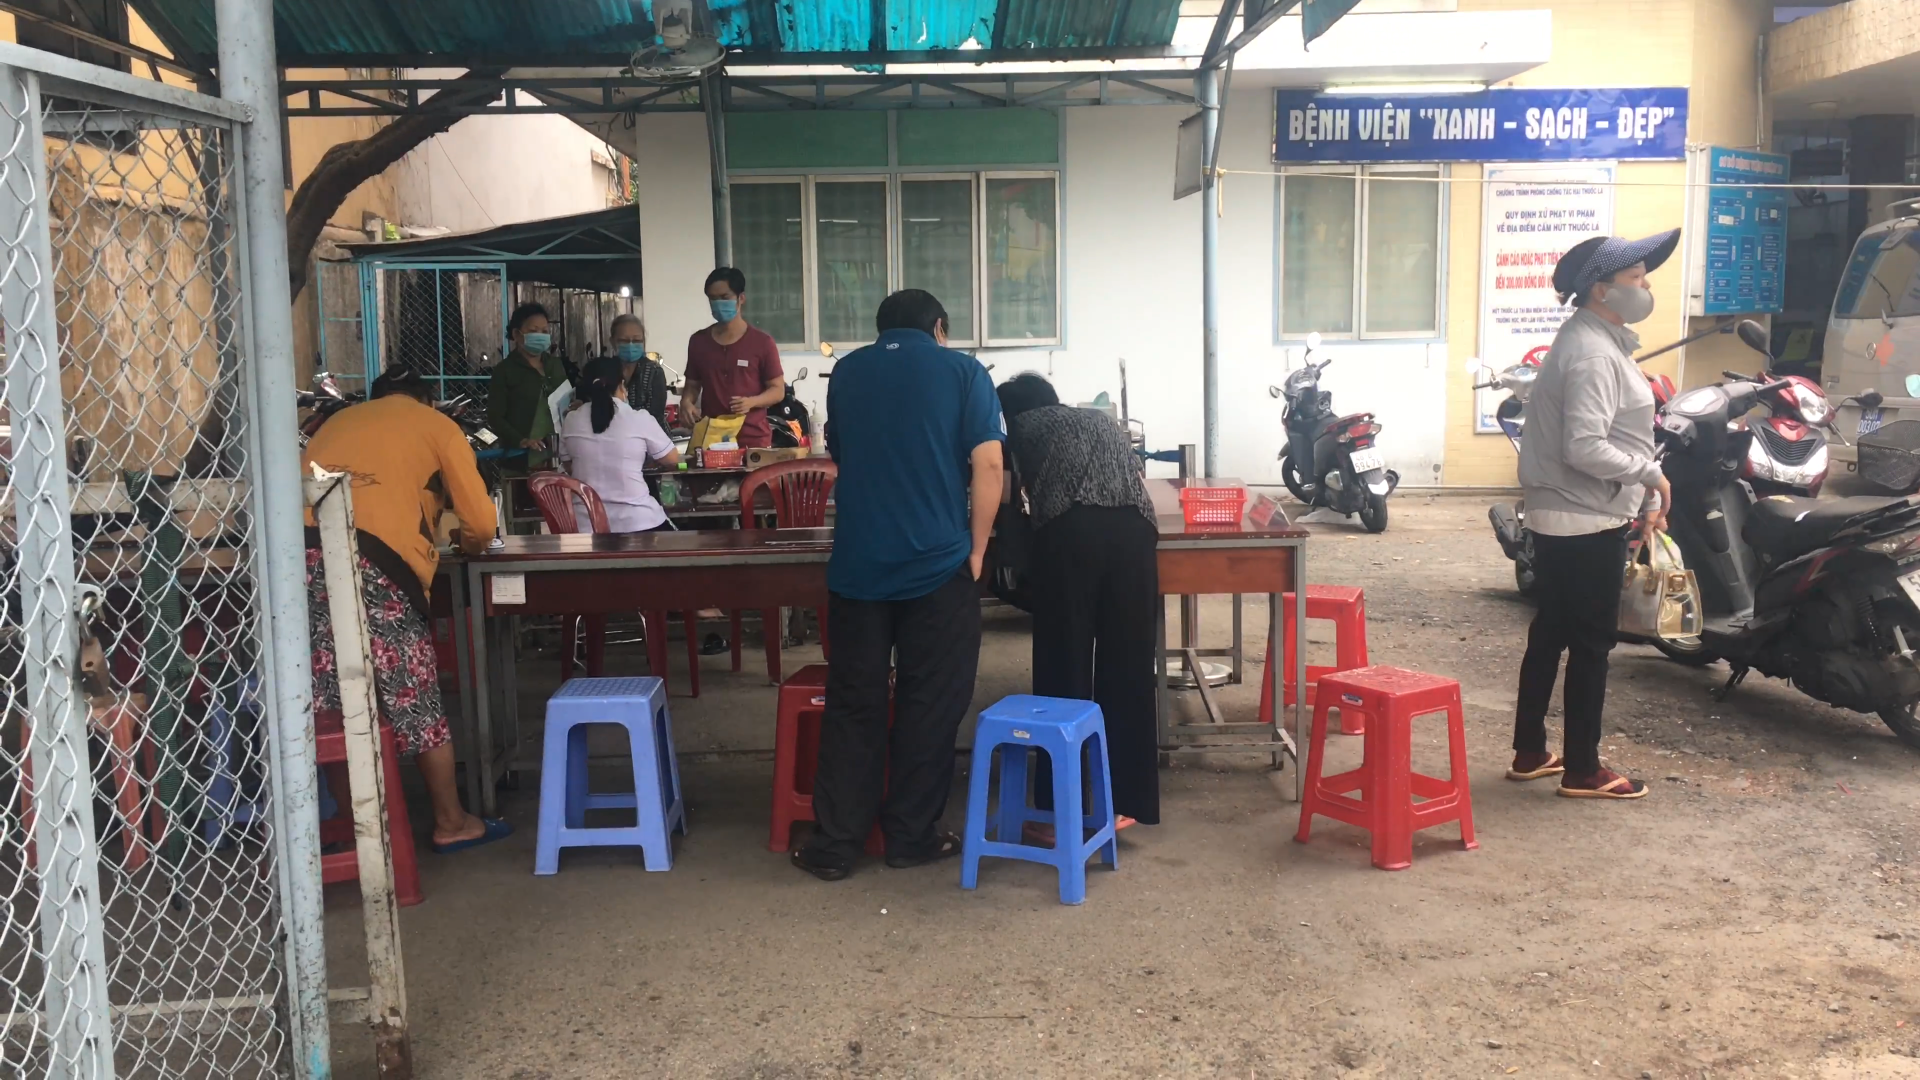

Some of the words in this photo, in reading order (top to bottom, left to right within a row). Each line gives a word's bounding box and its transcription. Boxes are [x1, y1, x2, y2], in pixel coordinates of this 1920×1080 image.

[1288, 102, 1350, 147] BỆNH
[1358, 102, 1411, 147] VIỆN
[1525, 106, 1588, 146] SẠCH
[1505, 211, 1519, 219] QUY
[1521, 210, 1537, 220] ĐỊNH
[1538, 207, 1548, 219] XỬ
[1549, 210, 1566, 220] PHẠT
[1568, 210, 1575, 218] VI
[1576, 209, 1595, 220] PHẠM
[1496, 222, 1505, 232] VỀ
[1507, 224, 1518, 235] ĐỊA
[1519, 221, 1536, 232] ĐIỂM
[1537, 222, 1552, 232] CẤM
[1553, 222, 1566, 232] HÚT
[1568, 222, 1590, 231] THUỐC
[1591, 221, 1600, 231] LÁ
[1496, 249, 1510, 267] CẢNH
[1510, 250, 1520, 266] CÁO
[1521, 250, 1534, 268] HOẶC
[1534, 252, 1547, 268] PHẠT
[1496, 273, 1506, 290] ĐẾN
[1524, 272, 1537, 289] ĐỒNG
